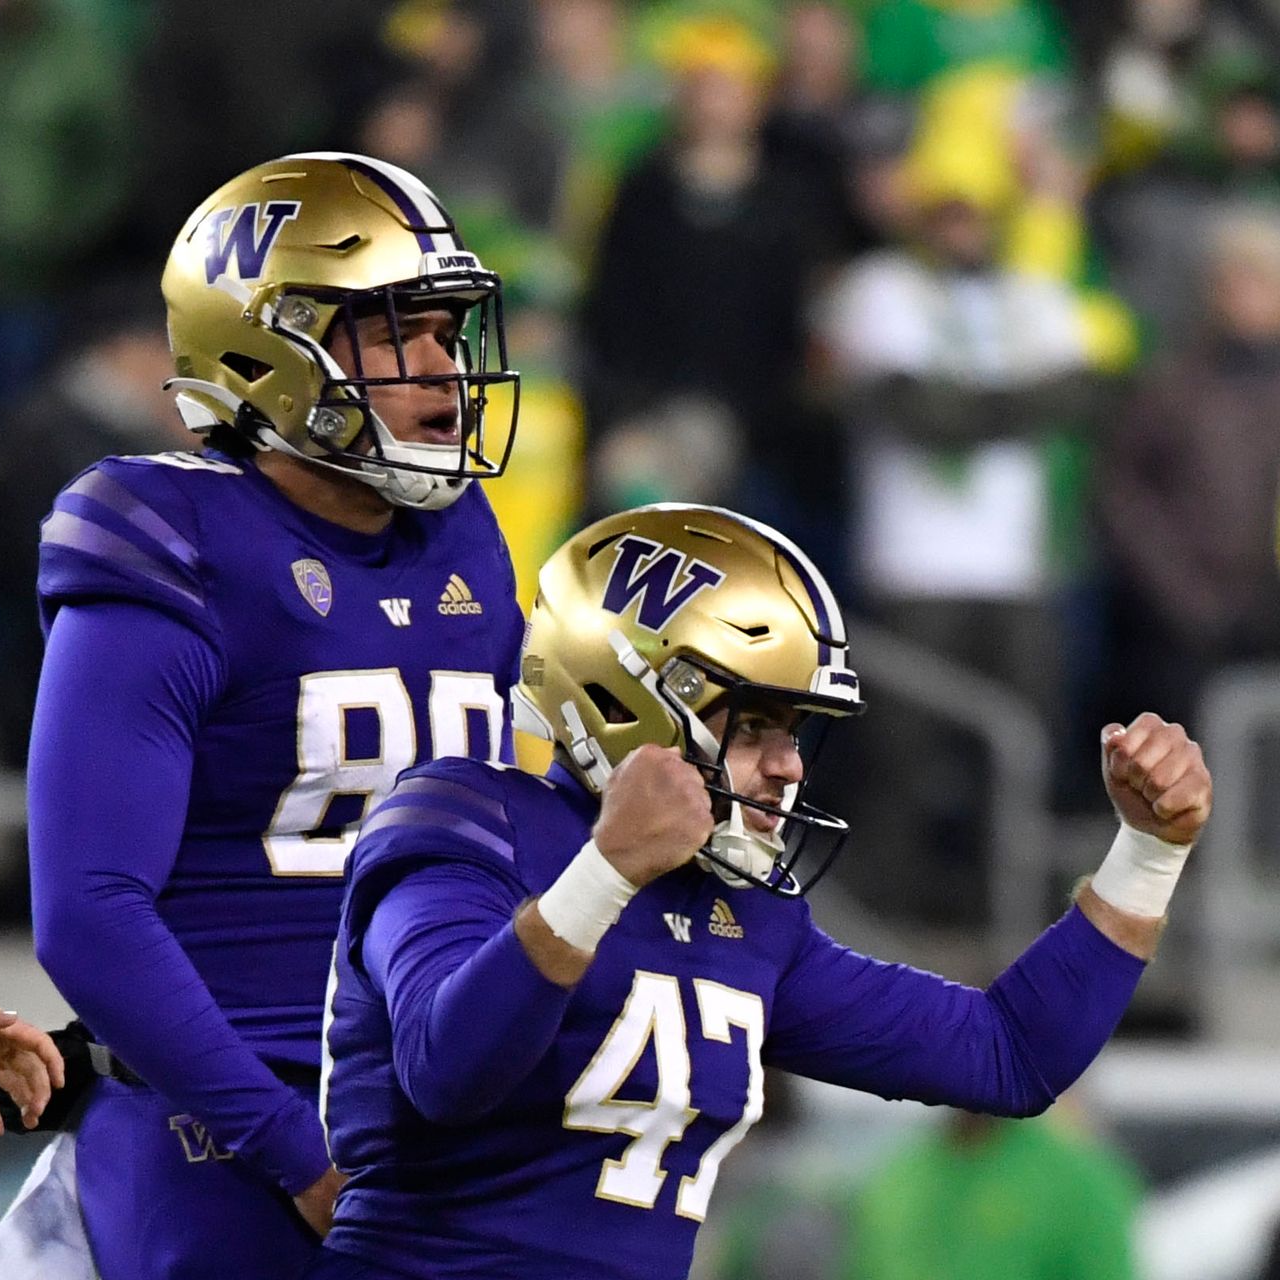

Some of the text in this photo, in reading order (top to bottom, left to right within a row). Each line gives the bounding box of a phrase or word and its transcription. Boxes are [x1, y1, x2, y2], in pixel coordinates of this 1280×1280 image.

[204, 201, 302, 288] W
[601, 535, 726, 634] W
[379, 598, 412, 627] W
[438, 601, 482, 615] adidas
[663, 913, 692, 943] W
[708, 922, 744, 938] adidas
[562, 969, 765, 1223] 47
